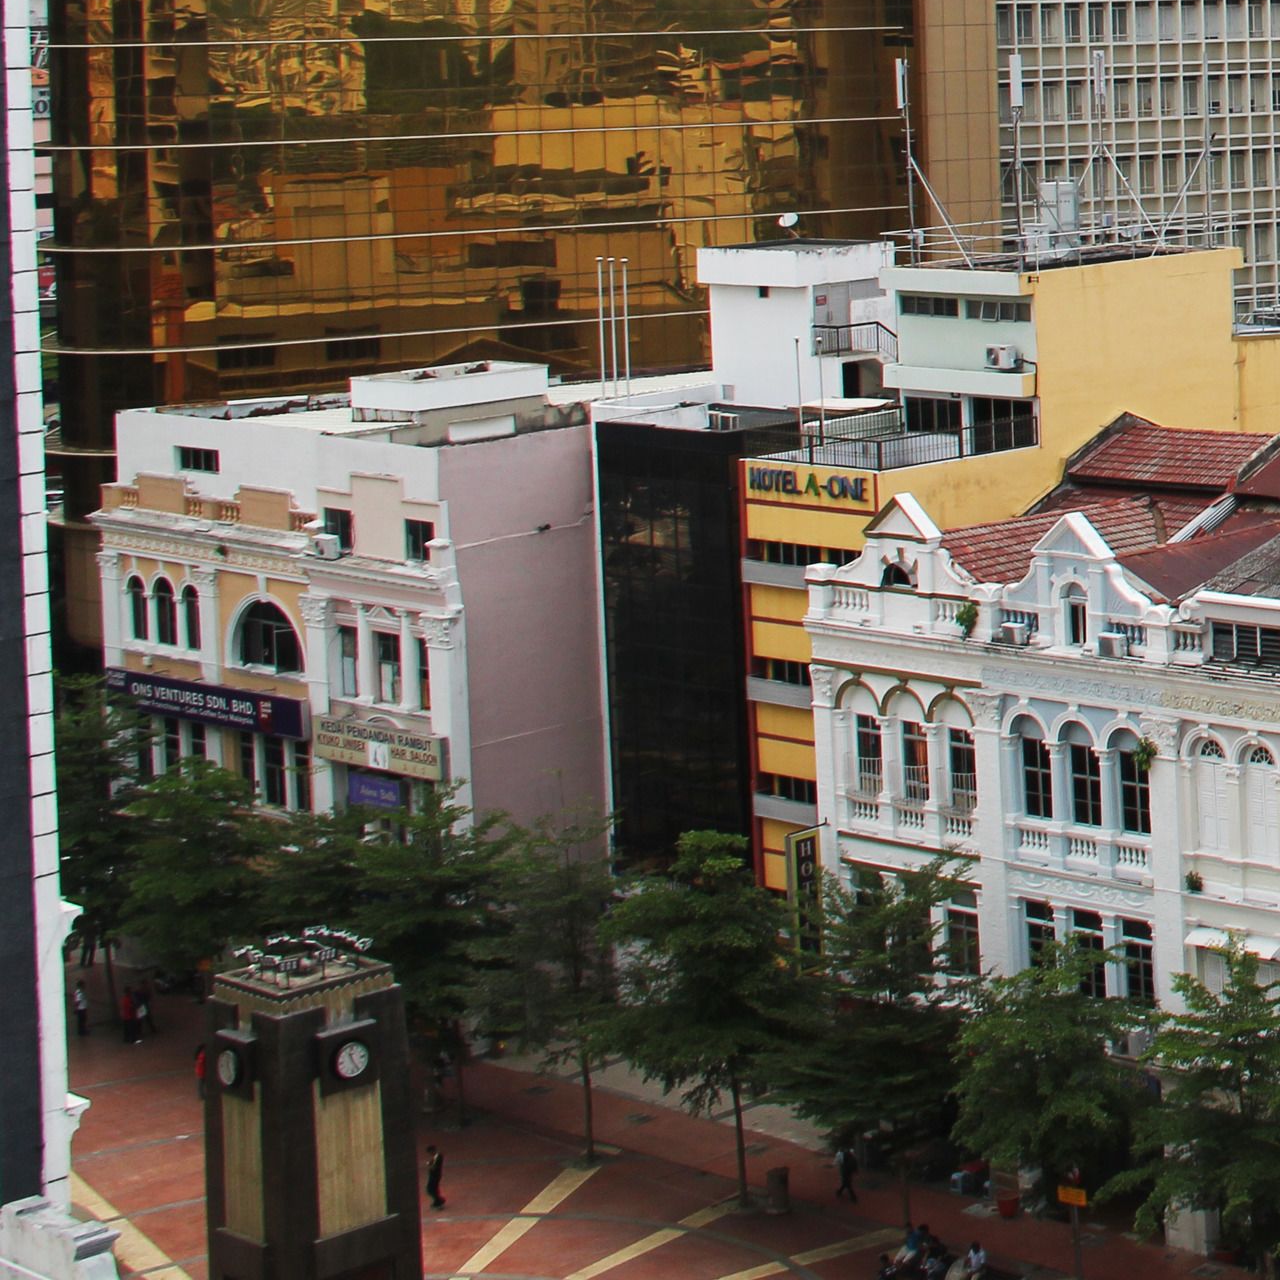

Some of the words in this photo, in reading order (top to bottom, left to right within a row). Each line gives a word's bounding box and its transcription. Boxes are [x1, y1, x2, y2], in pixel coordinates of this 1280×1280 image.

[749, 466, 803, 496] HOTEL
[804, 473, 869, 502] A-ONE
[154, 686, 204, 706] VENTURES
[206, 694, 229, 711] SDN.
[232, 699, 256, 716] BHD.
